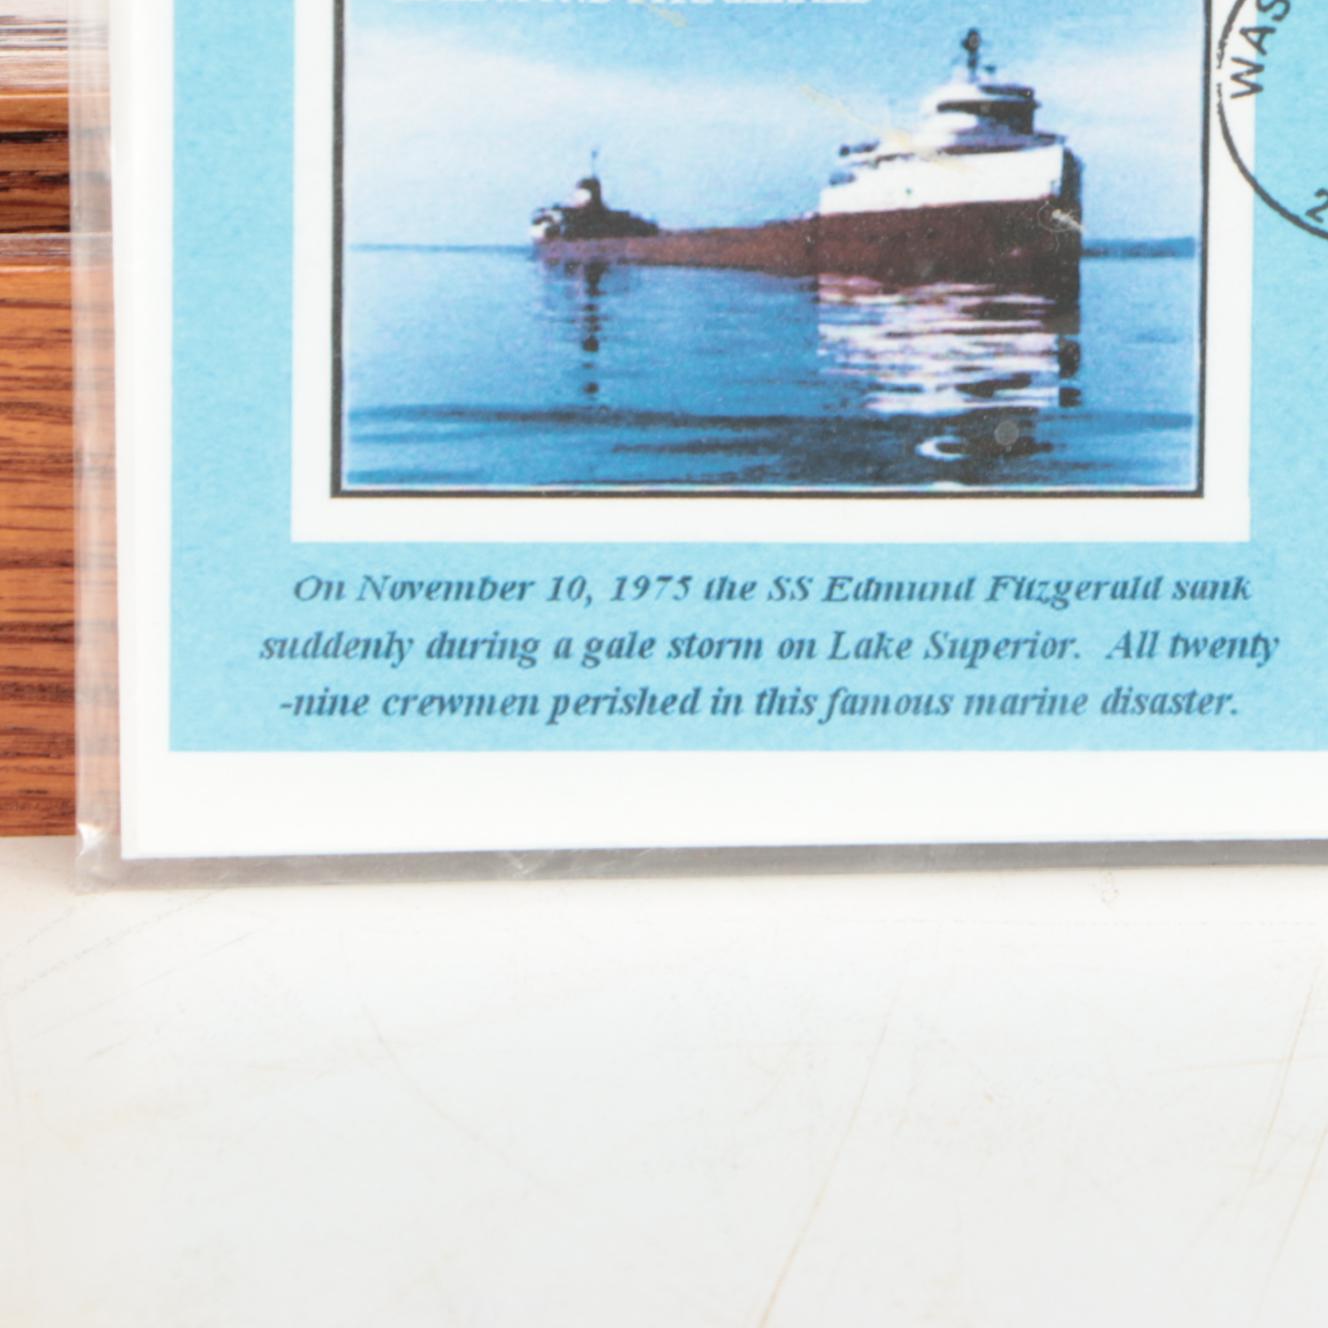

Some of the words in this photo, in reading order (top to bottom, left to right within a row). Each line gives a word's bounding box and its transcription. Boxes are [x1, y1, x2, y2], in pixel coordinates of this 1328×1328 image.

[293, 574, 345, 602] On
[355, 574, 535, 602] November
[545, 574, 594, 608] 10,
[610, 574, 691, 601] 1975
[704, 574, 756, 601] the
[767, 574, 811, 603] SS
[821, 575, 975, 602] Edmund
[985, 574, 1164, 609] Fitzgerald
[1171, 575, 1252, 601] sank
[258, 630, 413, 669] suddenly
[426, 630, 541, 669] during
[553, 637, 574, 660] a
[581, 630, 656, 669] gale
[666, 634, 763, 660] storm
[776, 636, 817, 660] on
[827, 630, 913, 660] Lake
[923, 629, 1082, 669] Superior.
[1105, 630, 1158, 660] All
[1168, 631, 1280, 669] twenty
[279, 687, 369, 716] -nine
[382, 692, 539, 716] crewmen
[545, 686, 701, 725] perished
[711, 687, 742, 716] in
[754, 687, 816, 716] this
[818, 687, 951, 725] famous
[963, 687, 1088, 716] marine
[1100, 686, 1238, 716] disaster.
